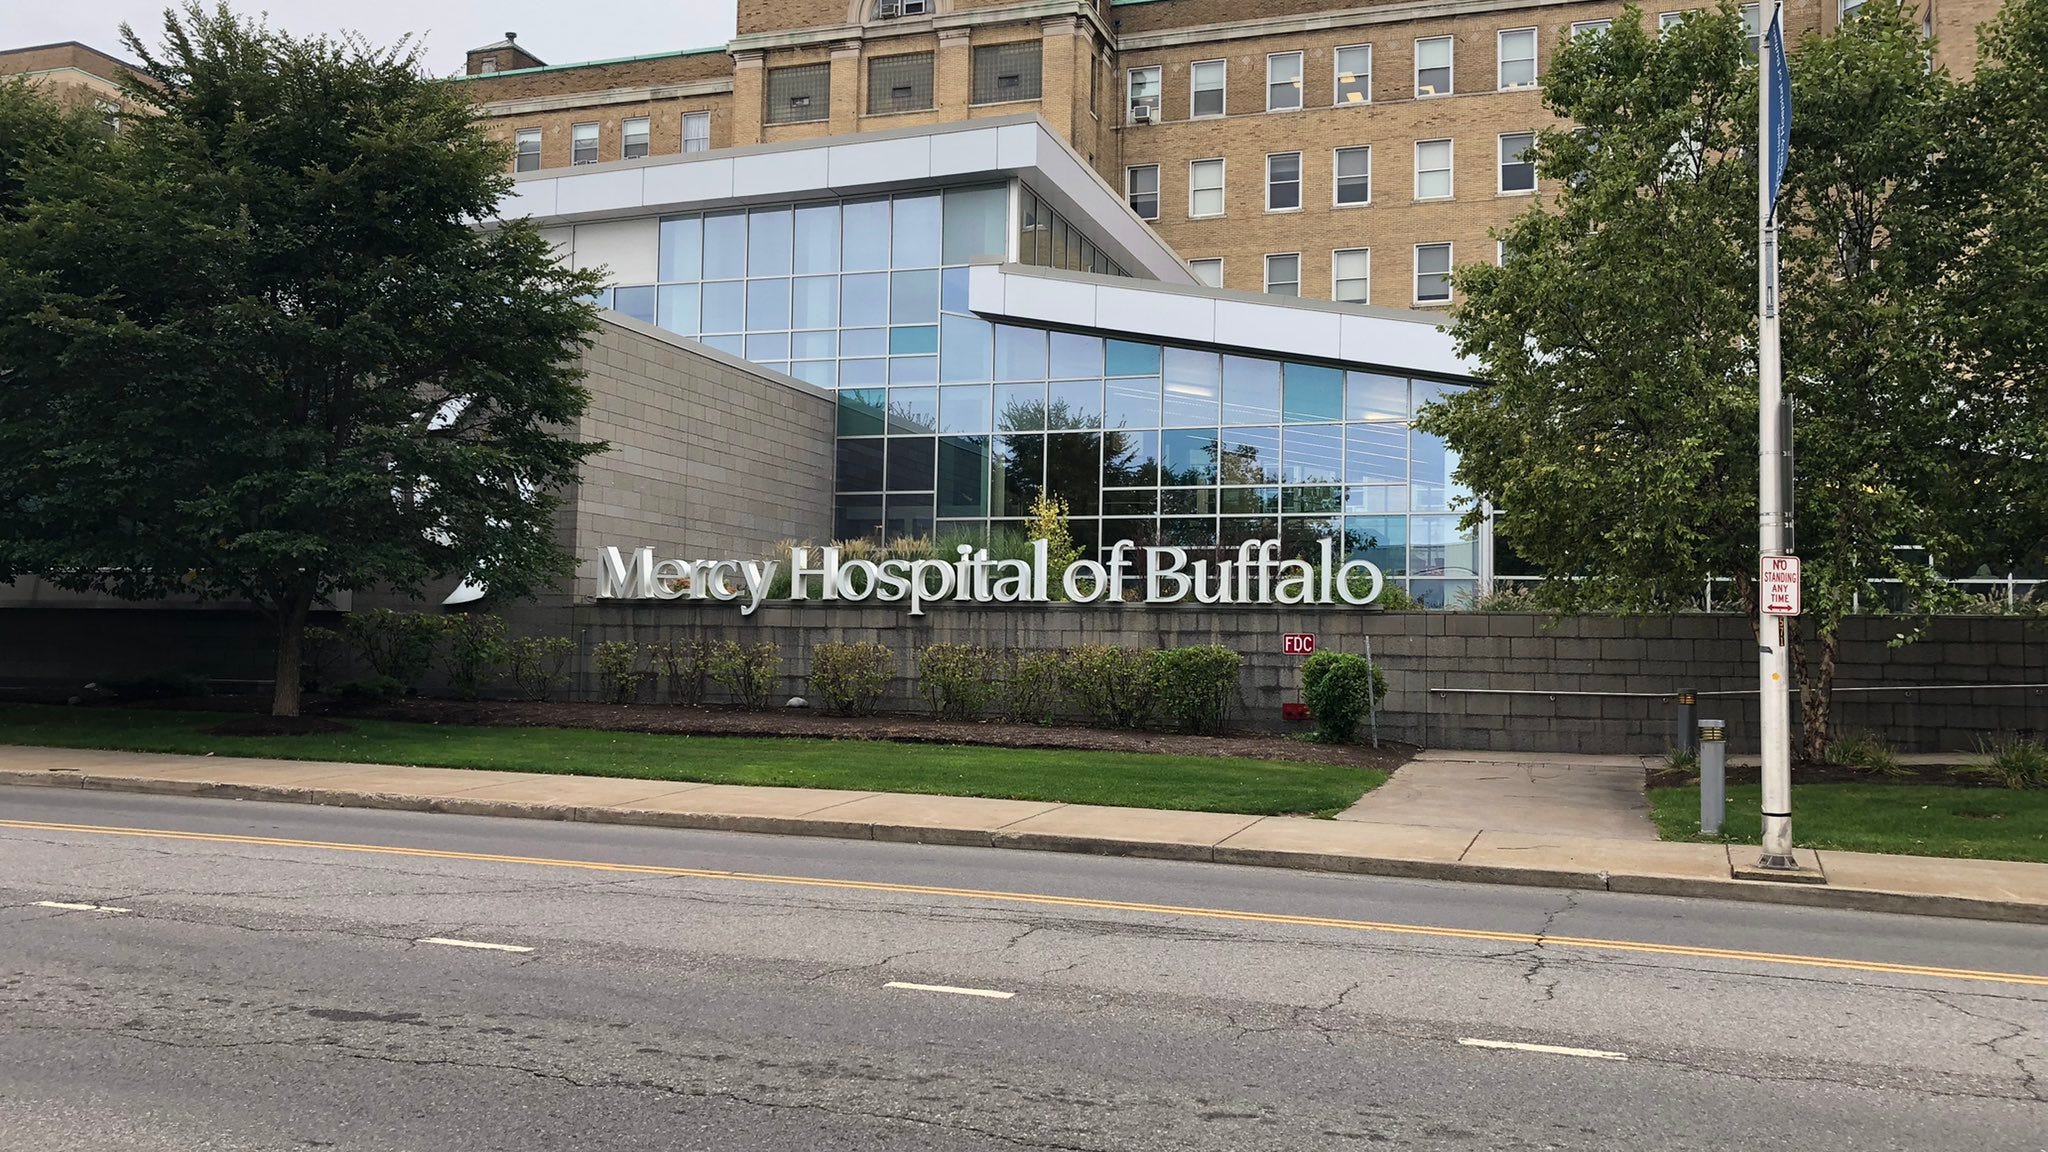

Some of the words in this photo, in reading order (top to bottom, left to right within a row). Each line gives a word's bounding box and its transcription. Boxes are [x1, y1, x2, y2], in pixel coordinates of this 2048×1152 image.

[1773, 560, 1787, 570] NO
[596, 545, 780, 616] Mercy
[790, 538, 1050, 616] Hospital
[1063, 539, 1134, 604] of
[1142, 538, 1383, 605] Buffalo
[1764, 572, 1796, 583] STANDING
[1772, 585, 1788, 593] ANY
[1771, 594, 1789, 603] TIME
[1285, 636, 1313, 652] FDC
